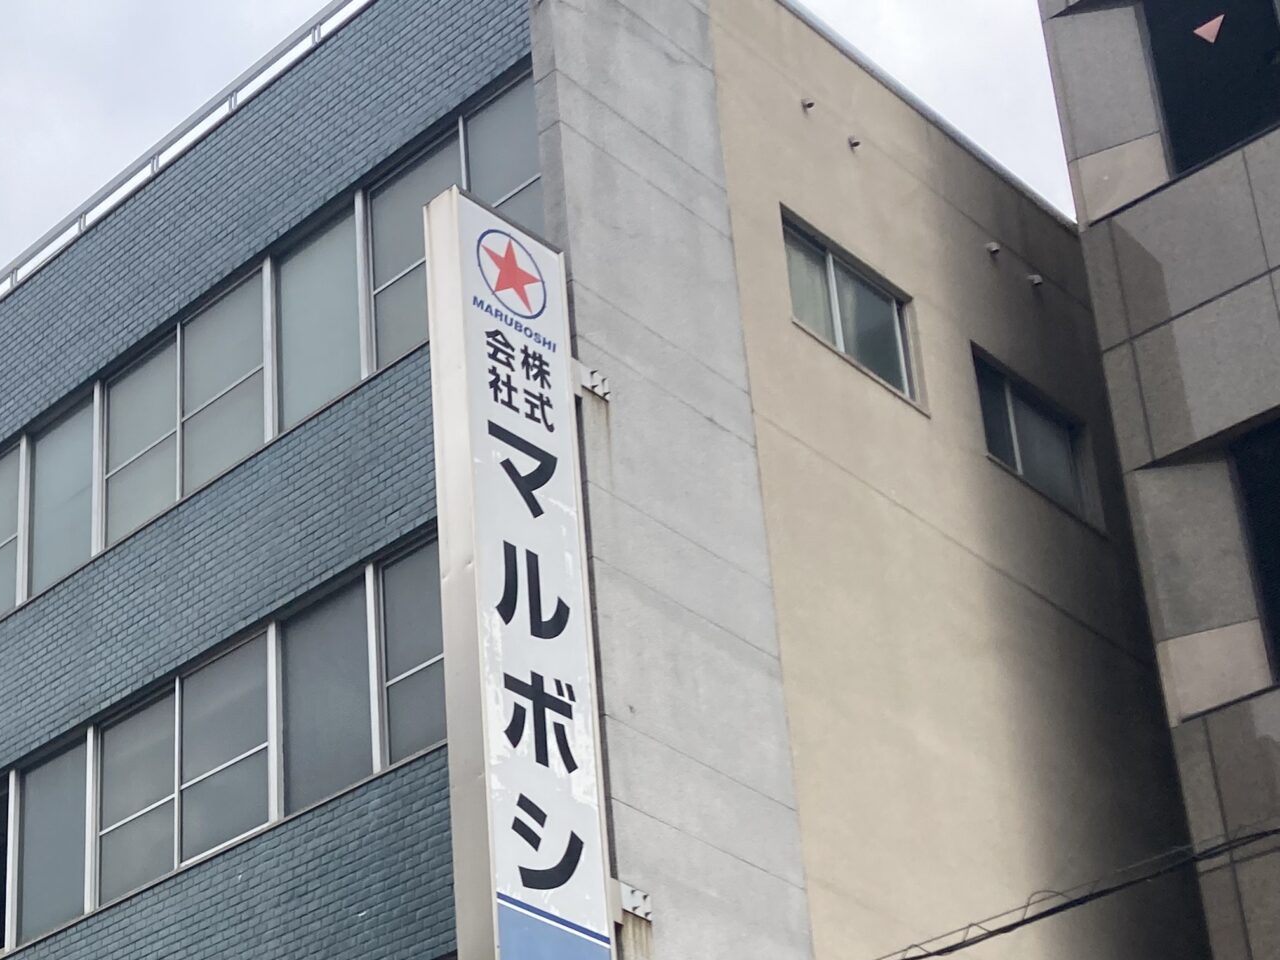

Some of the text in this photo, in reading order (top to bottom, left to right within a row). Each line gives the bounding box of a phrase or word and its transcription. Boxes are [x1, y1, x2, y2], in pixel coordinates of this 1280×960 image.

[472, 295, 557, 353] MARUBOSHI
[488, 419, 584, 891] マルボシ
